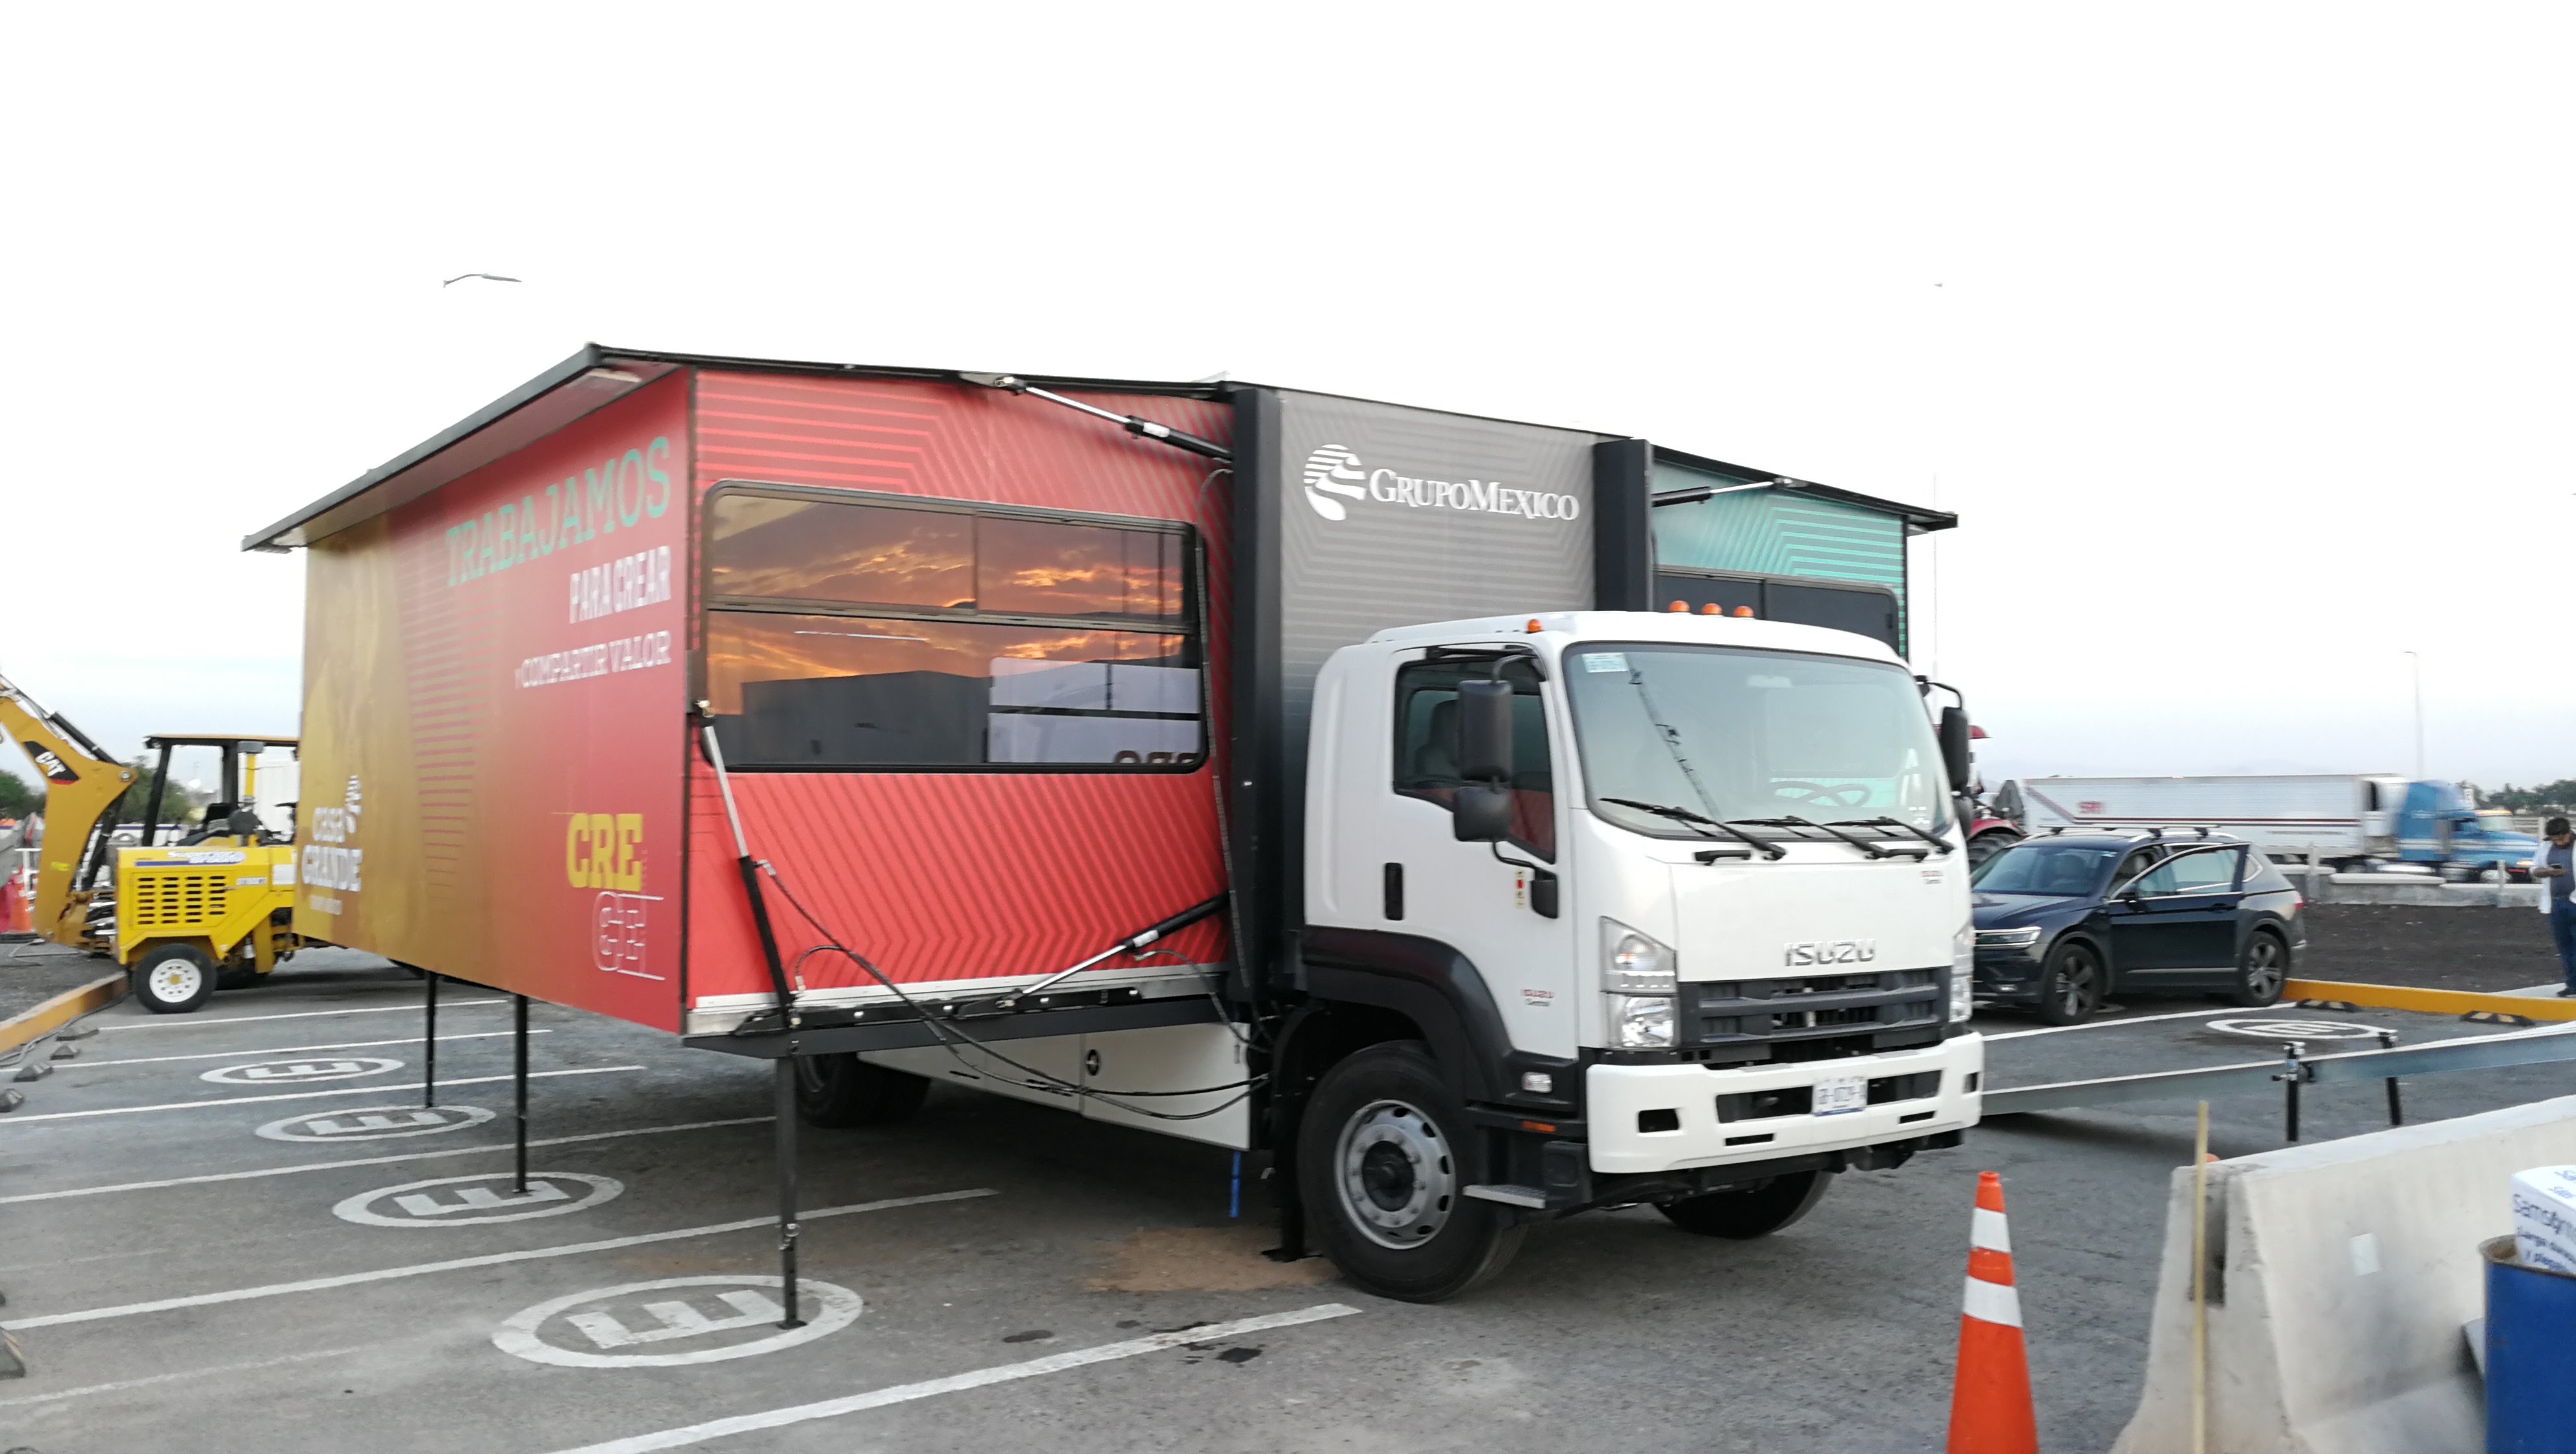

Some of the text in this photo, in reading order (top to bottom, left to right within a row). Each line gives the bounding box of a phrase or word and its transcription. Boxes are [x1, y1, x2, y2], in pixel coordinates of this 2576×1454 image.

[445, 436, 671, 587] TRABAJAMOS
[569, 545, 671, 624] PARA CREAR
[522, 644, 609, 688] COMPARTIR
[609, 630, 671, 672] VALOR
[35, 750, 66, 777] CAT
[302, 844, 362, 893] GRANDE
[566, 813, 643, 892] CRE
[1784, 939, 1875, 967] ISUZU
